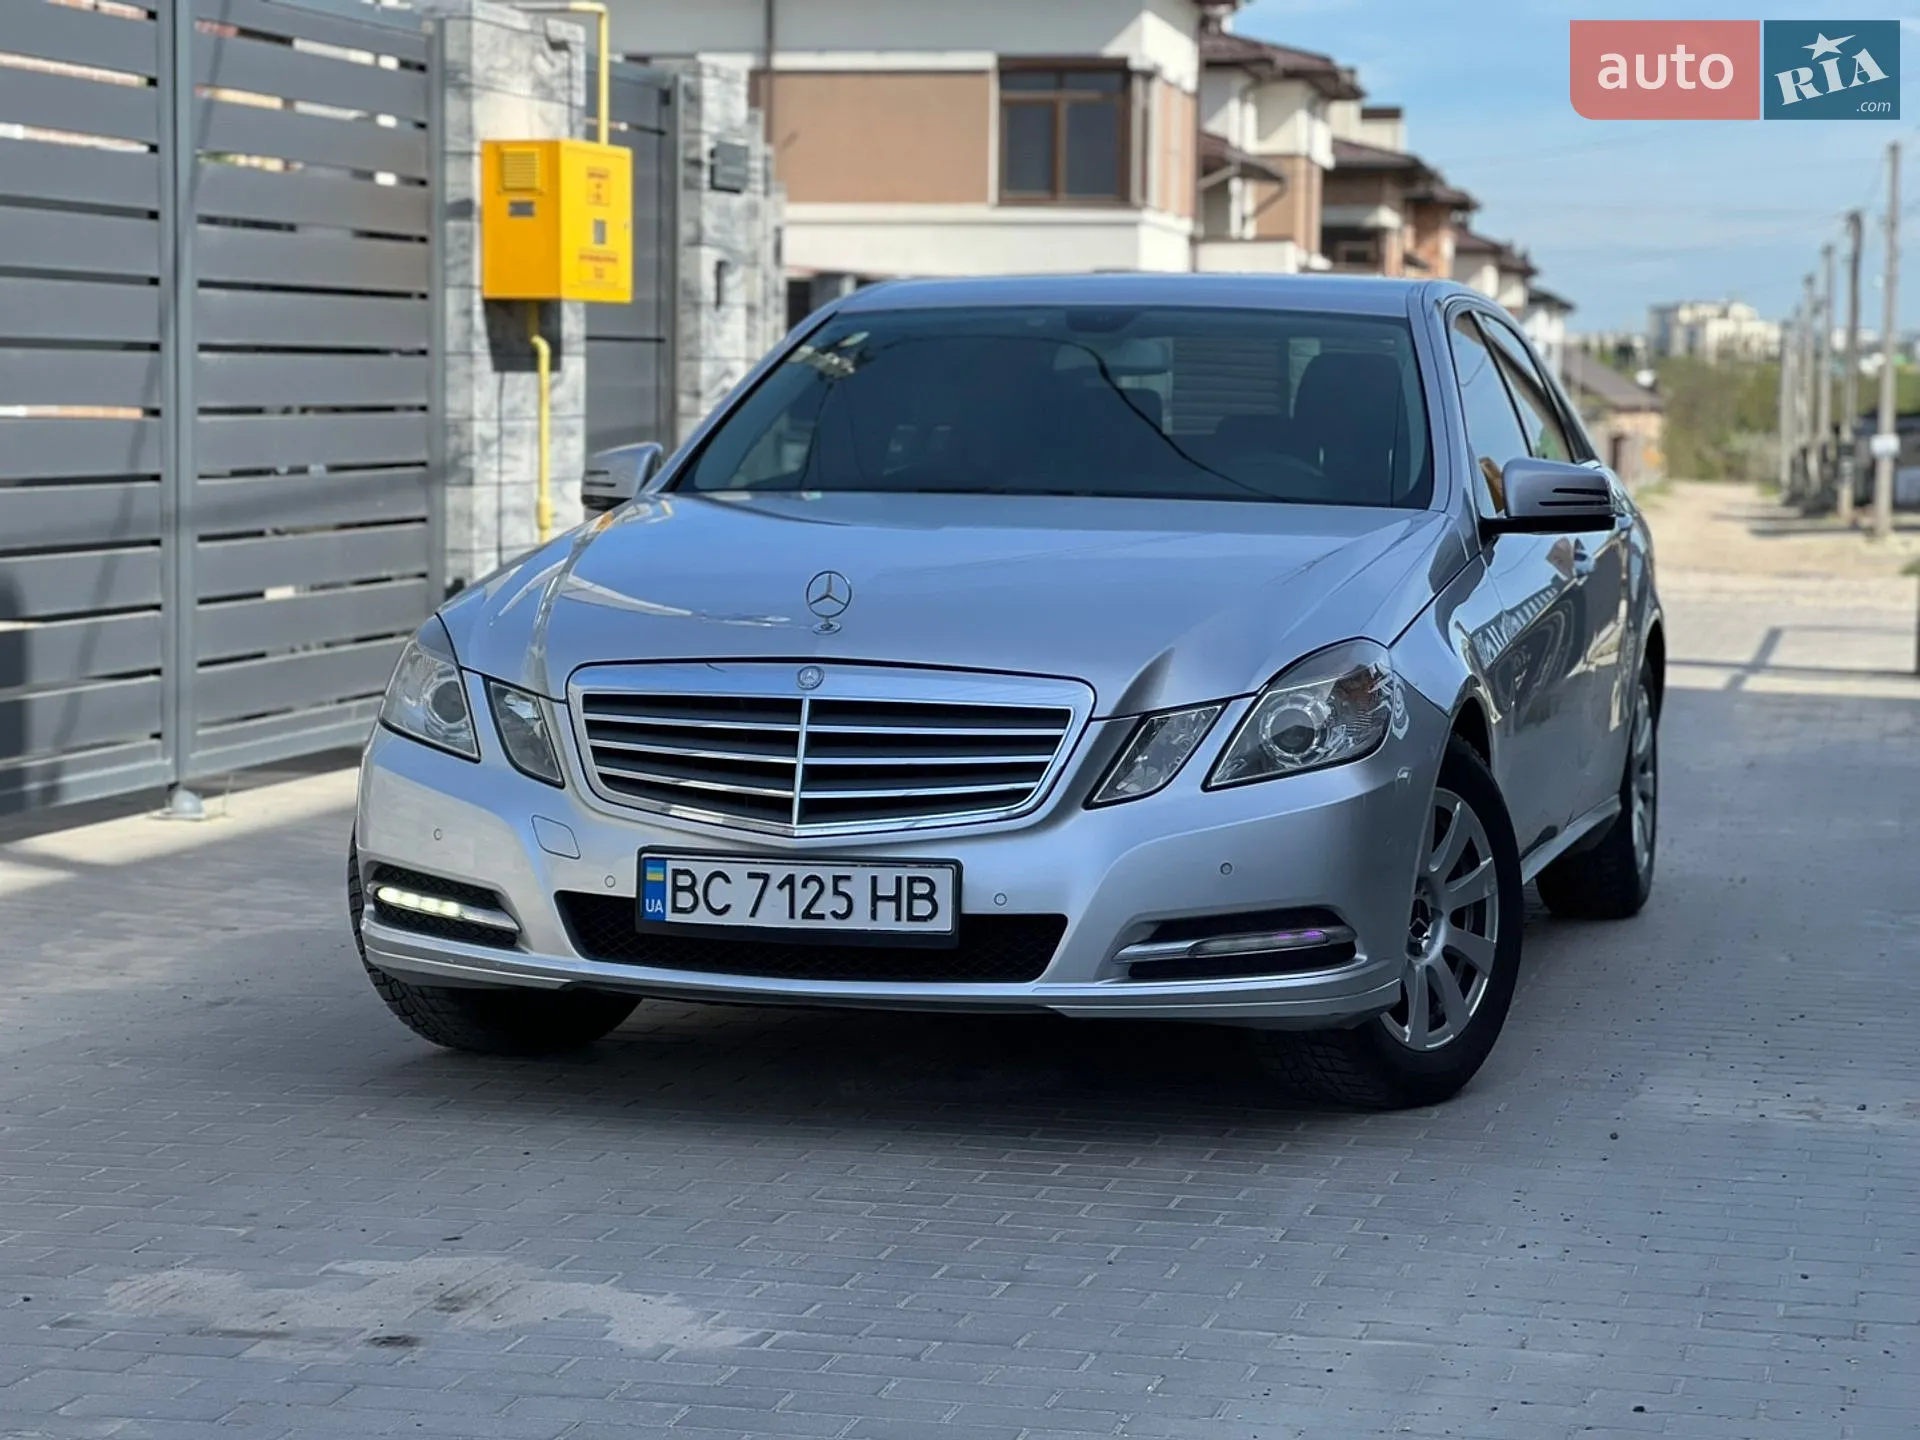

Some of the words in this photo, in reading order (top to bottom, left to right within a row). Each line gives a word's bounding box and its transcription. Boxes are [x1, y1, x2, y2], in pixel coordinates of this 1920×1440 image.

[645, 898, 664, 914] UA
[671, 868, 732, 916] BC
[747, 871, 854, 921] 7125
[869, 874, 939, 922] HB
